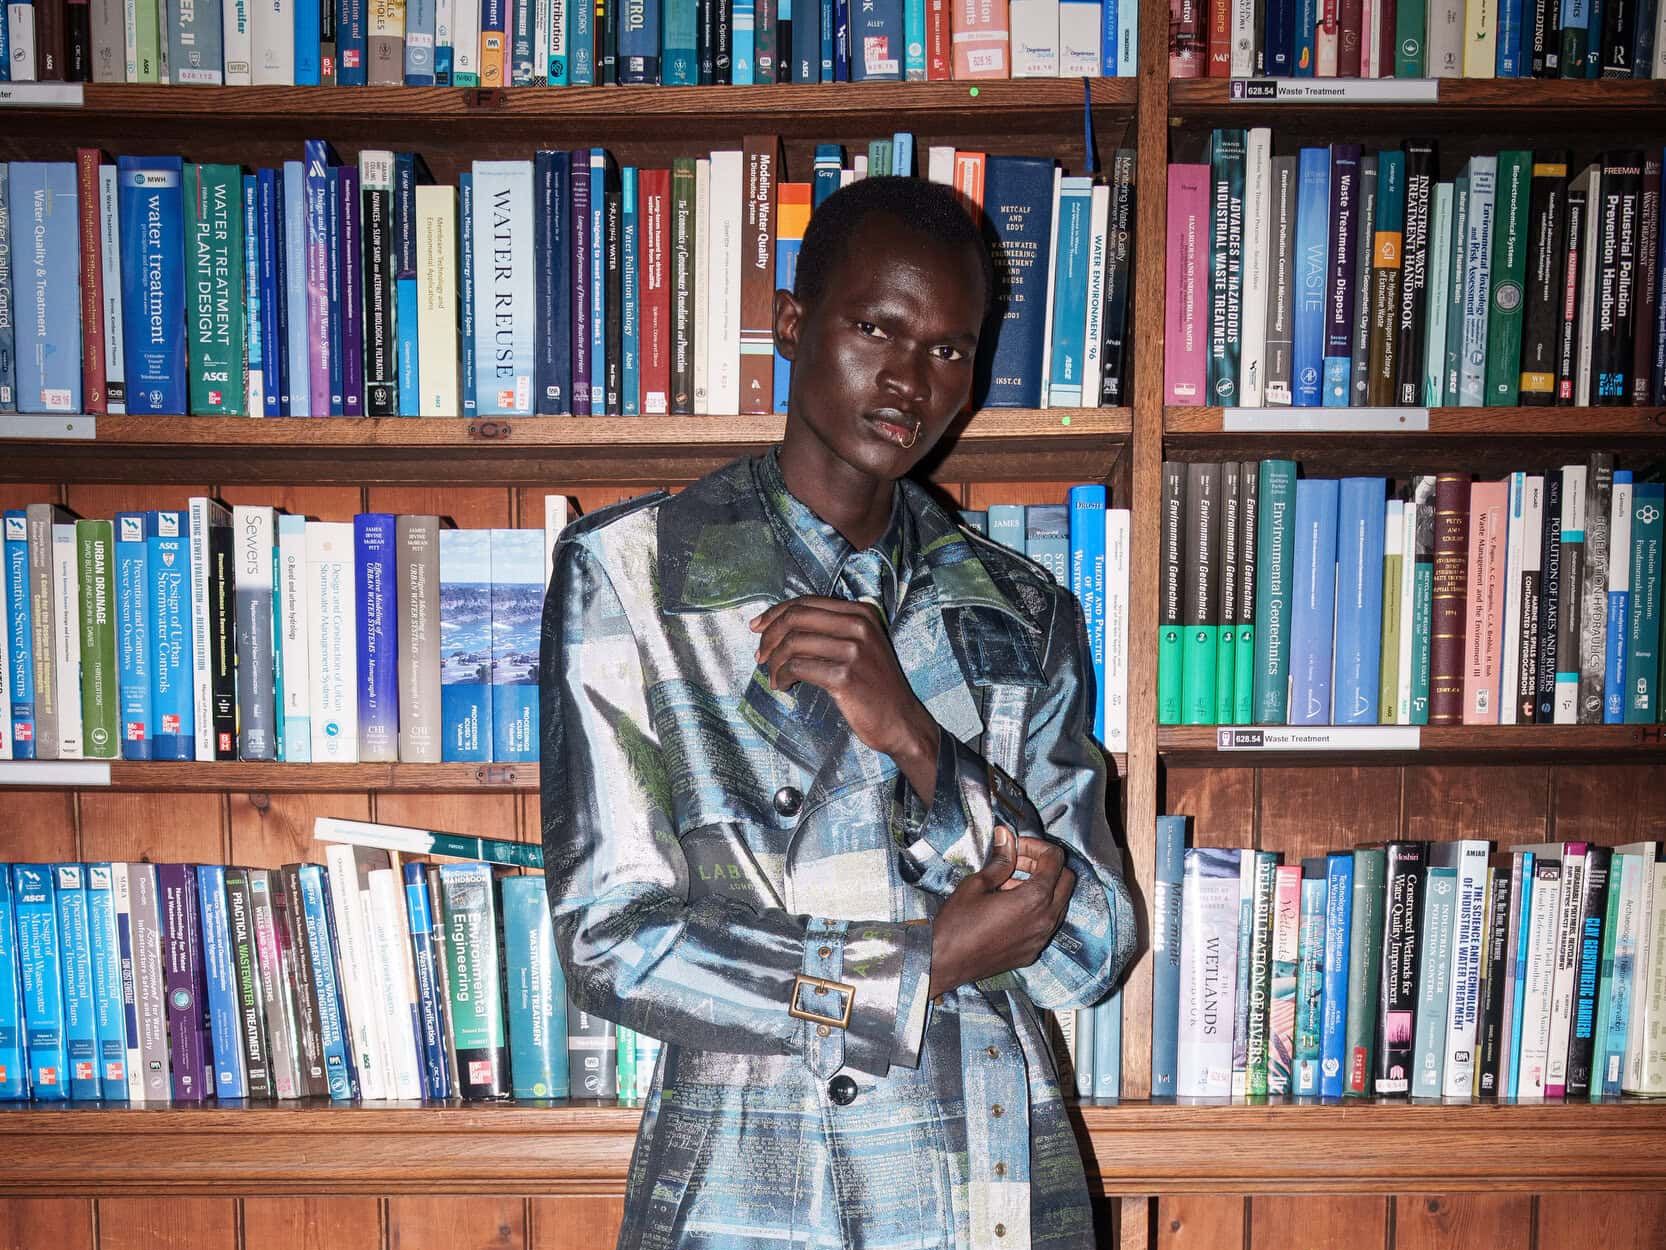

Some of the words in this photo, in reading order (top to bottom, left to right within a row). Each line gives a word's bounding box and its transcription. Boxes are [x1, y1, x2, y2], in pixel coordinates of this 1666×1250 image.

[717, 24, 727, 51] Options
[801, 60, 809, 78] ASCE
[1248, 86, 1274, 96] 628.54
[1278, 86, 1303, 96] Waste
[1306, 86, 1345, 96] Treatment
[0, 89, 12, 98] ter
[757, 155, 769, 201] Modeling
[1119, 158, 1130, 202] Monitoring
[1340, 175, 1350, 207] Waste
[1604, 167, 1639, 175] FREEMAN
[35, 190, 44, 223] Water
[148, 195, 163, 247] water
[215, 185, 227, 240] WATER
[759, 203, 769, 232] Water
[1119, 205, 1128, 229] Water
[1216, 182, 1228, 249] INDUSTRIAL
[1229, 198, 1240, 256] ADVANCES
[1405, 175, 1419, 252] TREATMENT
[1417, 176, 1429, 247] INDUSTRIAL
[1621, 196, 1634, 256] Industrial
[33, 226, 45, 266] Quality
[198, 223, 210, 275] PLANT
[494, 190, 512, 282] WATER
[625, 225, 633, 253] Water
[756, 234, 768, 269] Quality
[1093, 236, 1102, 267] WATER
[1116, 232, 1127, 262] Quality
[1338, 211, 1349, 264] Treatment
[1604, 196, 1617, 265] Prevention
[36, 269, 45, 277] &
[1216, 253, 1226, 290] WASTE
[1229, 260, 1239, 272] IN
[1305, 244, 1323, 312] WASTE
[1415, 250, 1425, 288] WASTE
[1618, 262, 1631, 316] Pollution
[36, 281, 46, 336] Treatment
[150, 254, 165, 343] treatment
[199, 282, 211, 343] DESIGN
[216, 247, 228, 345] TREATMENT
[1090, 271, 1100, 341] ENVIRONMENT
[1227, 277, 1239, 343] HAZARDOUS
[1334, 279, 1346, 323] Disposal
[1402, 255, 1415, 329] HANDBOOK
[1601, 269, 1614, 331] Handbook
[495, 294, 513, 378] REUSE
[624, 302, 633, 336] Biology
[1214, 294, 1225, 358] TREATMENT
[1089, 345, 1097, 359] '96
[203, 372, 228, 382] ASCE
[245, 516, 261, 574] Sewers
[993, 520, 1020, 528] JAMES
[1246, 499, 1255, 562] Environmental
[94, 541, 104, 573] URBAN
[1271, 502, 1285, 596] Environmental
[1550, 518, 1560, 580] POLLUTION
[13, 547, 25, 609] Alternative
[96, 577, 106, 624] DRAINAGE
[167, 573, 180, 613] Design
[1244, 565, 1253, 618] Geotechnics
[1550, 583, 1558, 596] OF
[158, 572, 169, 639] Stormwater
[171, 616, 180, 628] of
[1549, 599, 1557, 630] LAKES
[15, 613, 26, 647] Sewer
[171, 632, 180, 667] Urban
[1270, 600, 1283, 675] Geotechnics
[1548, 632, 1556, 656] AND
[13, 651, 26, 696] Systems
[159, 643, 170, 693] Controls
[1546, 658, 1555, 692] RIVERS
[1236, 734, 1261, 743] 628.54
[1265, 734, 1288, 743] Waste
[1291, 734, 1330, 743] Treatment
[1395, 874, 1405, 901] Water
[1405, 875, 1416, 933] Constructed
[1463, 878, 1472, 889] OF
[1473, 886, 1482, 900] THE
[233, 893, 247, 941] PRACTICAL
[1170, 882, 1182, 966] Man-made
[1255, 863, 1270, 986] REHABILITATION
[1391, 904, 1403, 940] Quality
[1460, 891, 1471, 944] INDUSTRIAL
[1471, 904, 1481, 942] SCIENCE
[1584, 918, 1600, 937] CLAY
[238, 944, 254, 1005] WASTEWATER
[453, 914, 471, 1001] Engineering
[470, 913, 485, 1016] Environmental
[1388, 943, 1402, 1004] Improvement
[1403, 936, 1413, 978] Wetlands
[1458, 947, 1468, 982] WATER
[1470, 945, 1479, 964] AND
[1580, 940, 1598, 996] GEOSYNTHETIC
[1205, 937, 1219, 1034] WETLANDS
[1254, 990, 1264, 1008] OF
[1402, 981, 1411, 995] for
[1455, 984, 1465, 1030] TREATMENT
[1466, 967, 1477, 1023] TECHNOLOGY
[246, 1009, 260, 1060] TREATMENT
[1251, 1013, 1263, 1064] RIVERS
[1577, 1000, 1593, 1037] BARRIERS
